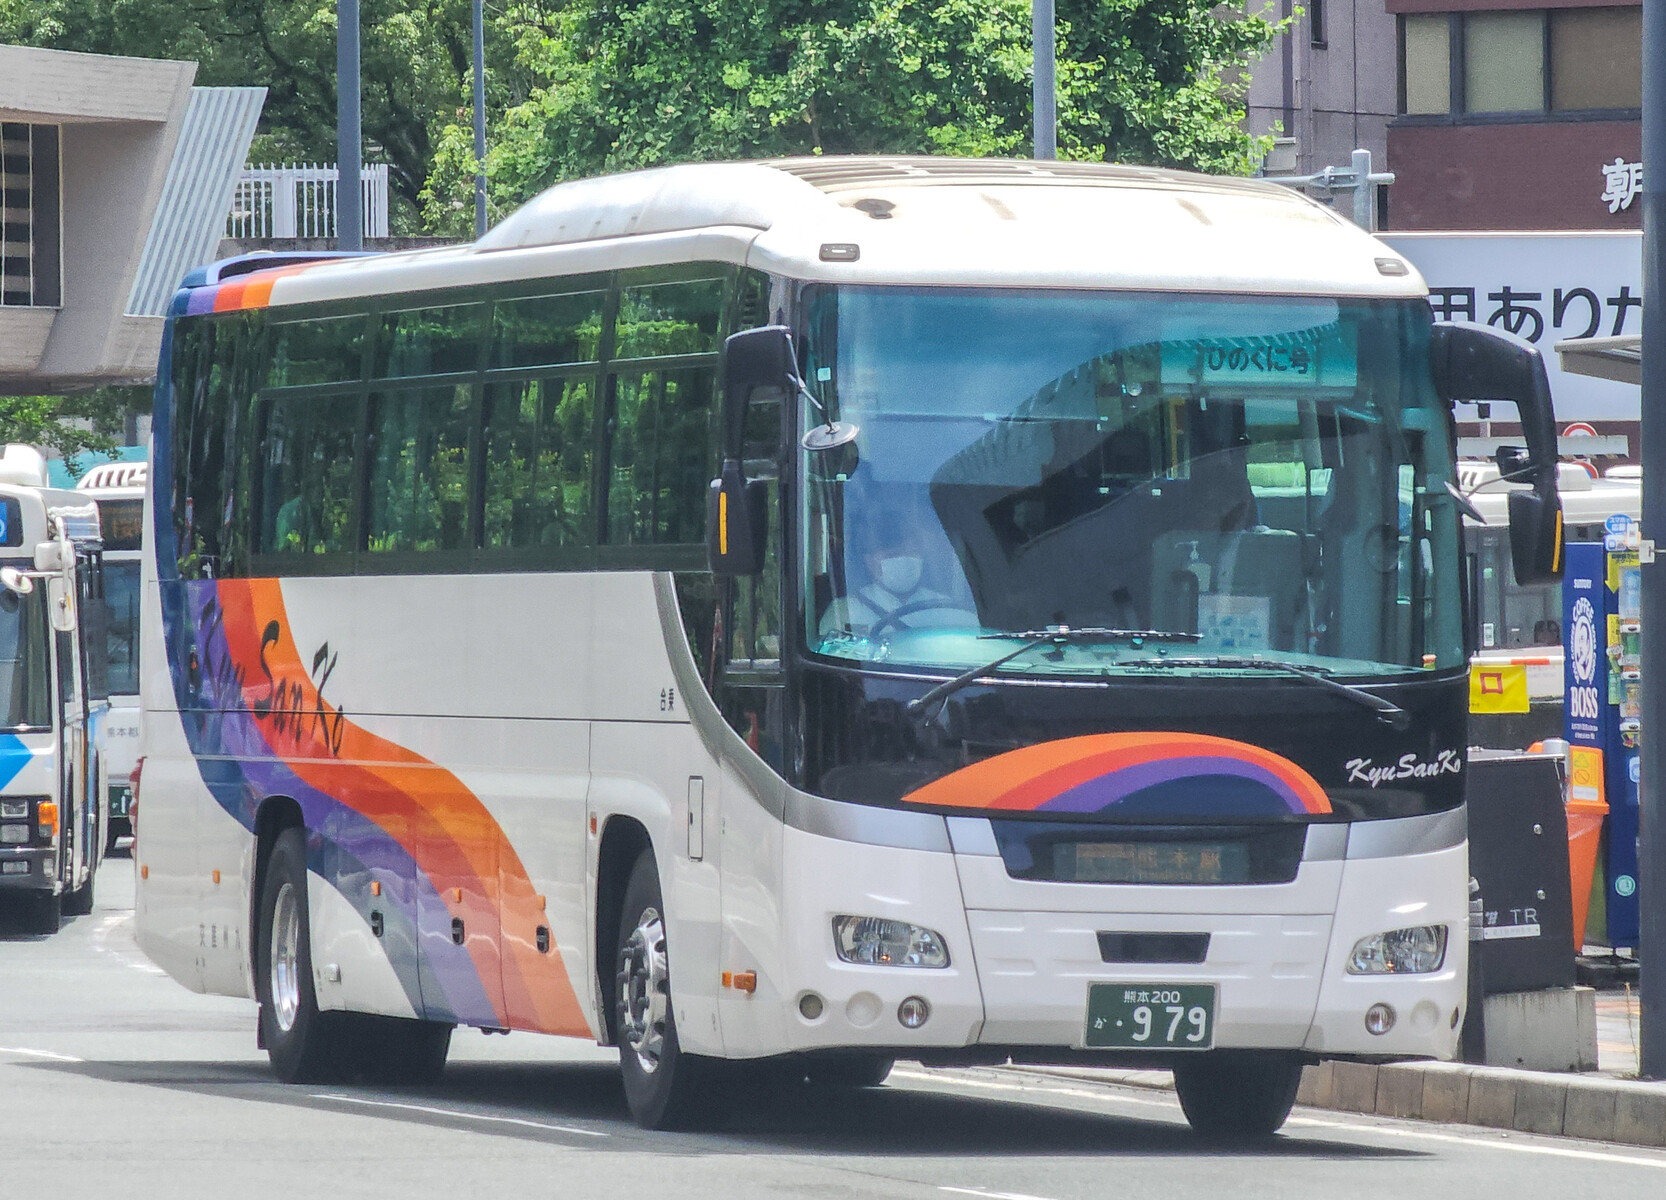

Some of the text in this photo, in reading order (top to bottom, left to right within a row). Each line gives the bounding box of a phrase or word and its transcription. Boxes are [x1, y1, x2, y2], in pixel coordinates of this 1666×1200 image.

[1207, 346, 1311, 375] ひのくに号
[1570, 686, 1598, 719] BOSS
[1345, 749, 1461, 788] KyuSanKo
